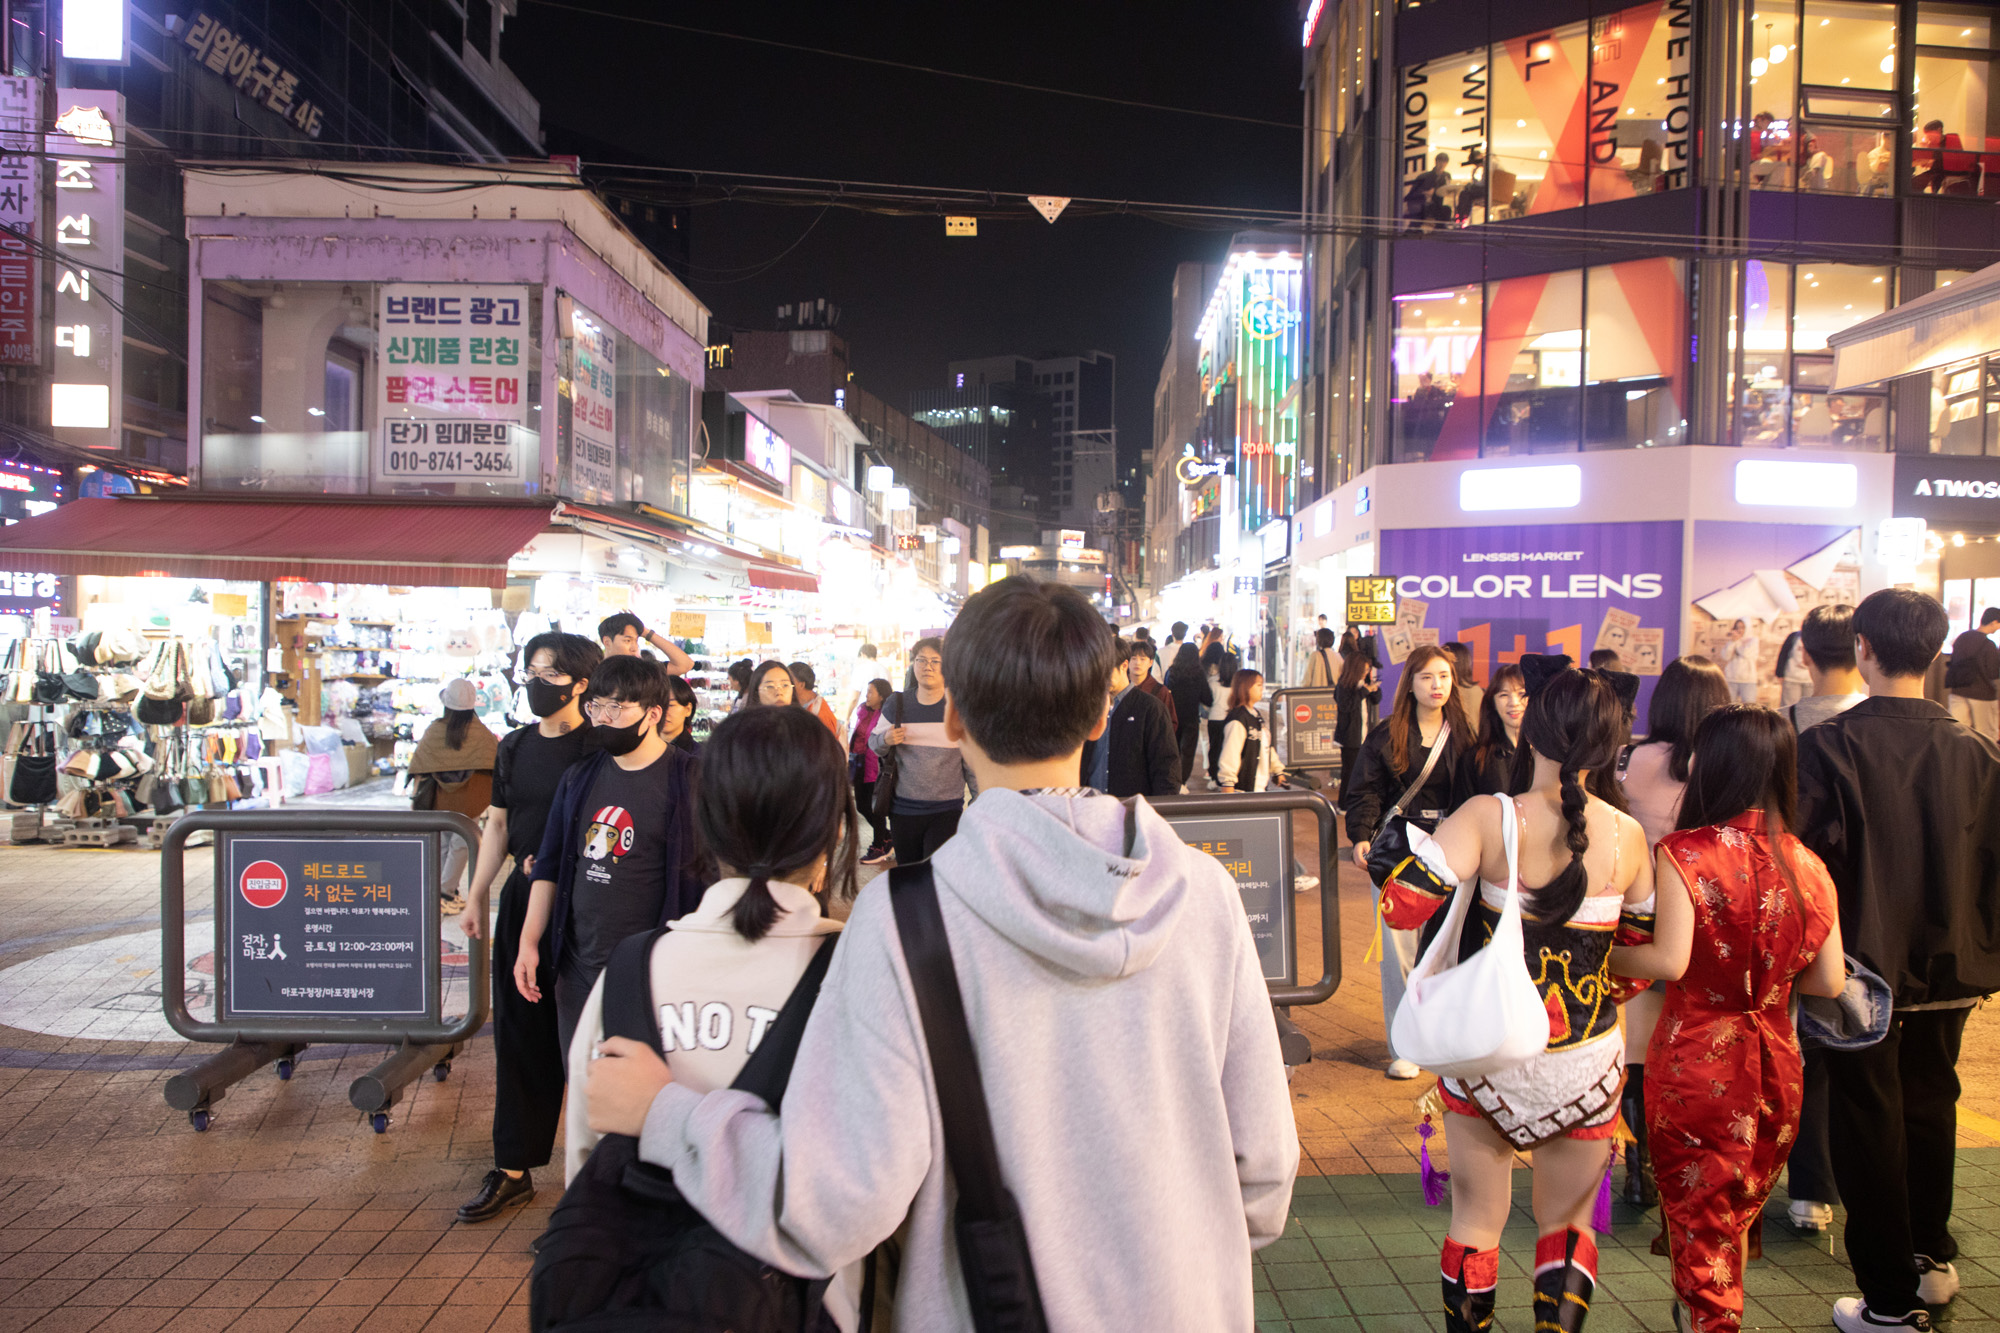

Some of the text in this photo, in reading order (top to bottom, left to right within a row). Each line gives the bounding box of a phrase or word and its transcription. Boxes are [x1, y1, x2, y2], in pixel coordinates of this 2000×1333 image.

[185, 13, 323, 134] 리얼야구존 4F
[1404, 62, 1428, 185] MOME
[1461, 64, 1486, 167] WITH
[1591, 81, 1618, 164] AND
[1664, 73, 1690, 191] HOPE
[55, 160, 94, 358] 조선시대
[386, 296, 521, 325] 브랜드 광고
[386, 336, 519, 366] 신제품 런칭
[386, 376, 519, 405] 팝업 스토어
[390, 423, 512, 446] 단기 임대문의
[390, 451, 513, 472] 010-8741-3454
[1914, 478, 2000, 499] A TWOS
[1463, 551, 1584, 563] LENSSIS MARKET
[1350, 579, 1395, 602] 반값
[1395, 573, 1663, 599] COLOR LENS
[1457, 622, 1582, 689] 1+1
[623, 829, 633, 849] 8
[304, 863, 367, 879] 레드로드
[1225, 861, 1252, 877] 거리
[249, 880, 279, 889] 진입금지
[304, 884, 391, 903] 차 없는 거리
[304, 924, 333, 933] 운영시간
[243, 948, 267, 960] 마포
[339, 941, 414, 952] 12:00~23:00까지
[659, 1001, 733, 1053] NO
